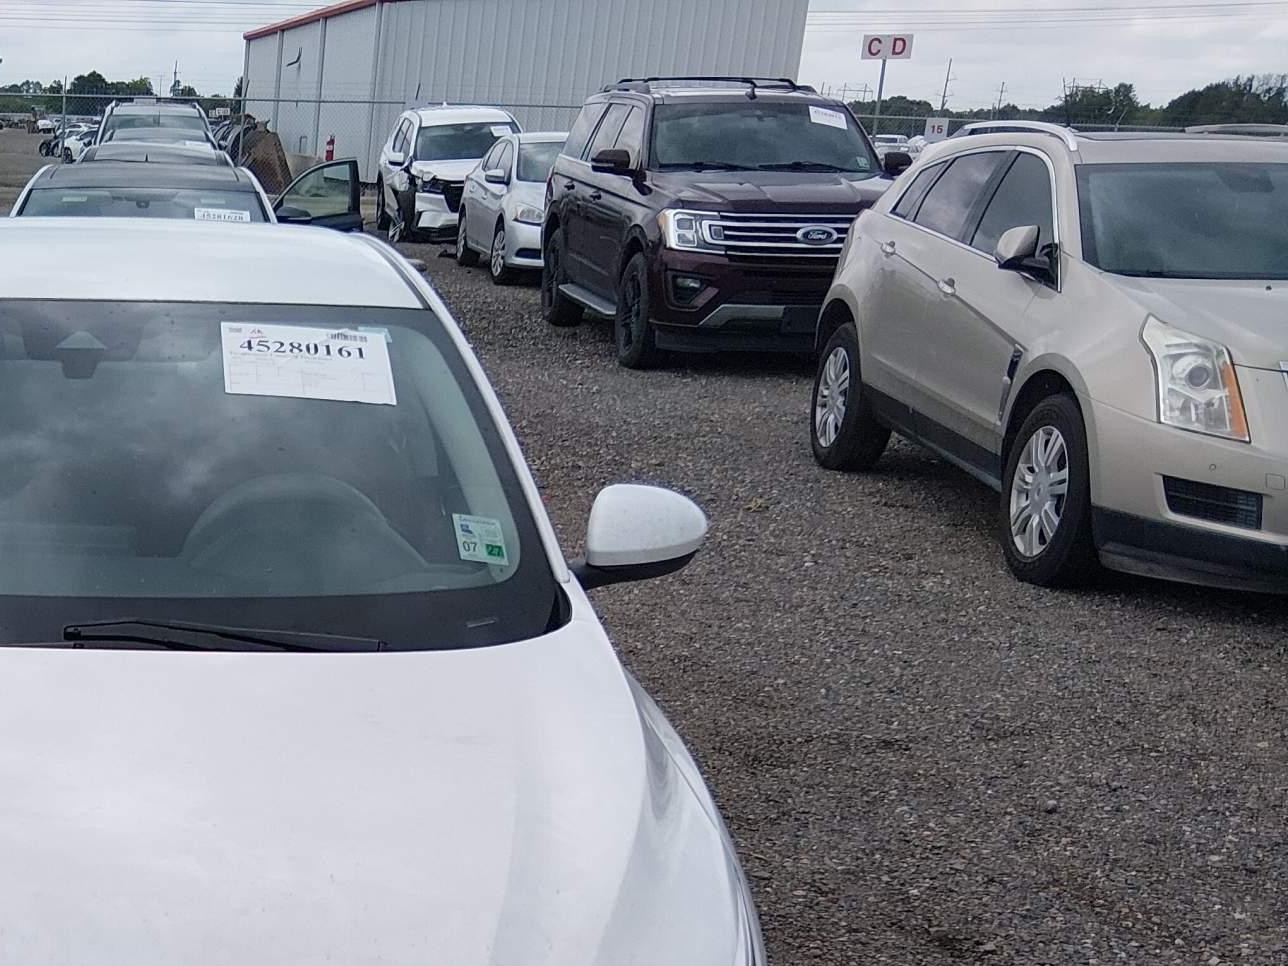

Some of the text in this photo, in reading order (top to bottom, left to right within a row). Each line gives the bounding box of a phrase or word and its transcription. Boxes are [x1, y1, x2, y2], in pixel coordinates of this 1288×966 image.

[867, 37, 907, 56] C D
[931, 124, 944, 135] 15
[239, 339, 366, 360] 45280161
[462, 540, 478, 553] 07
